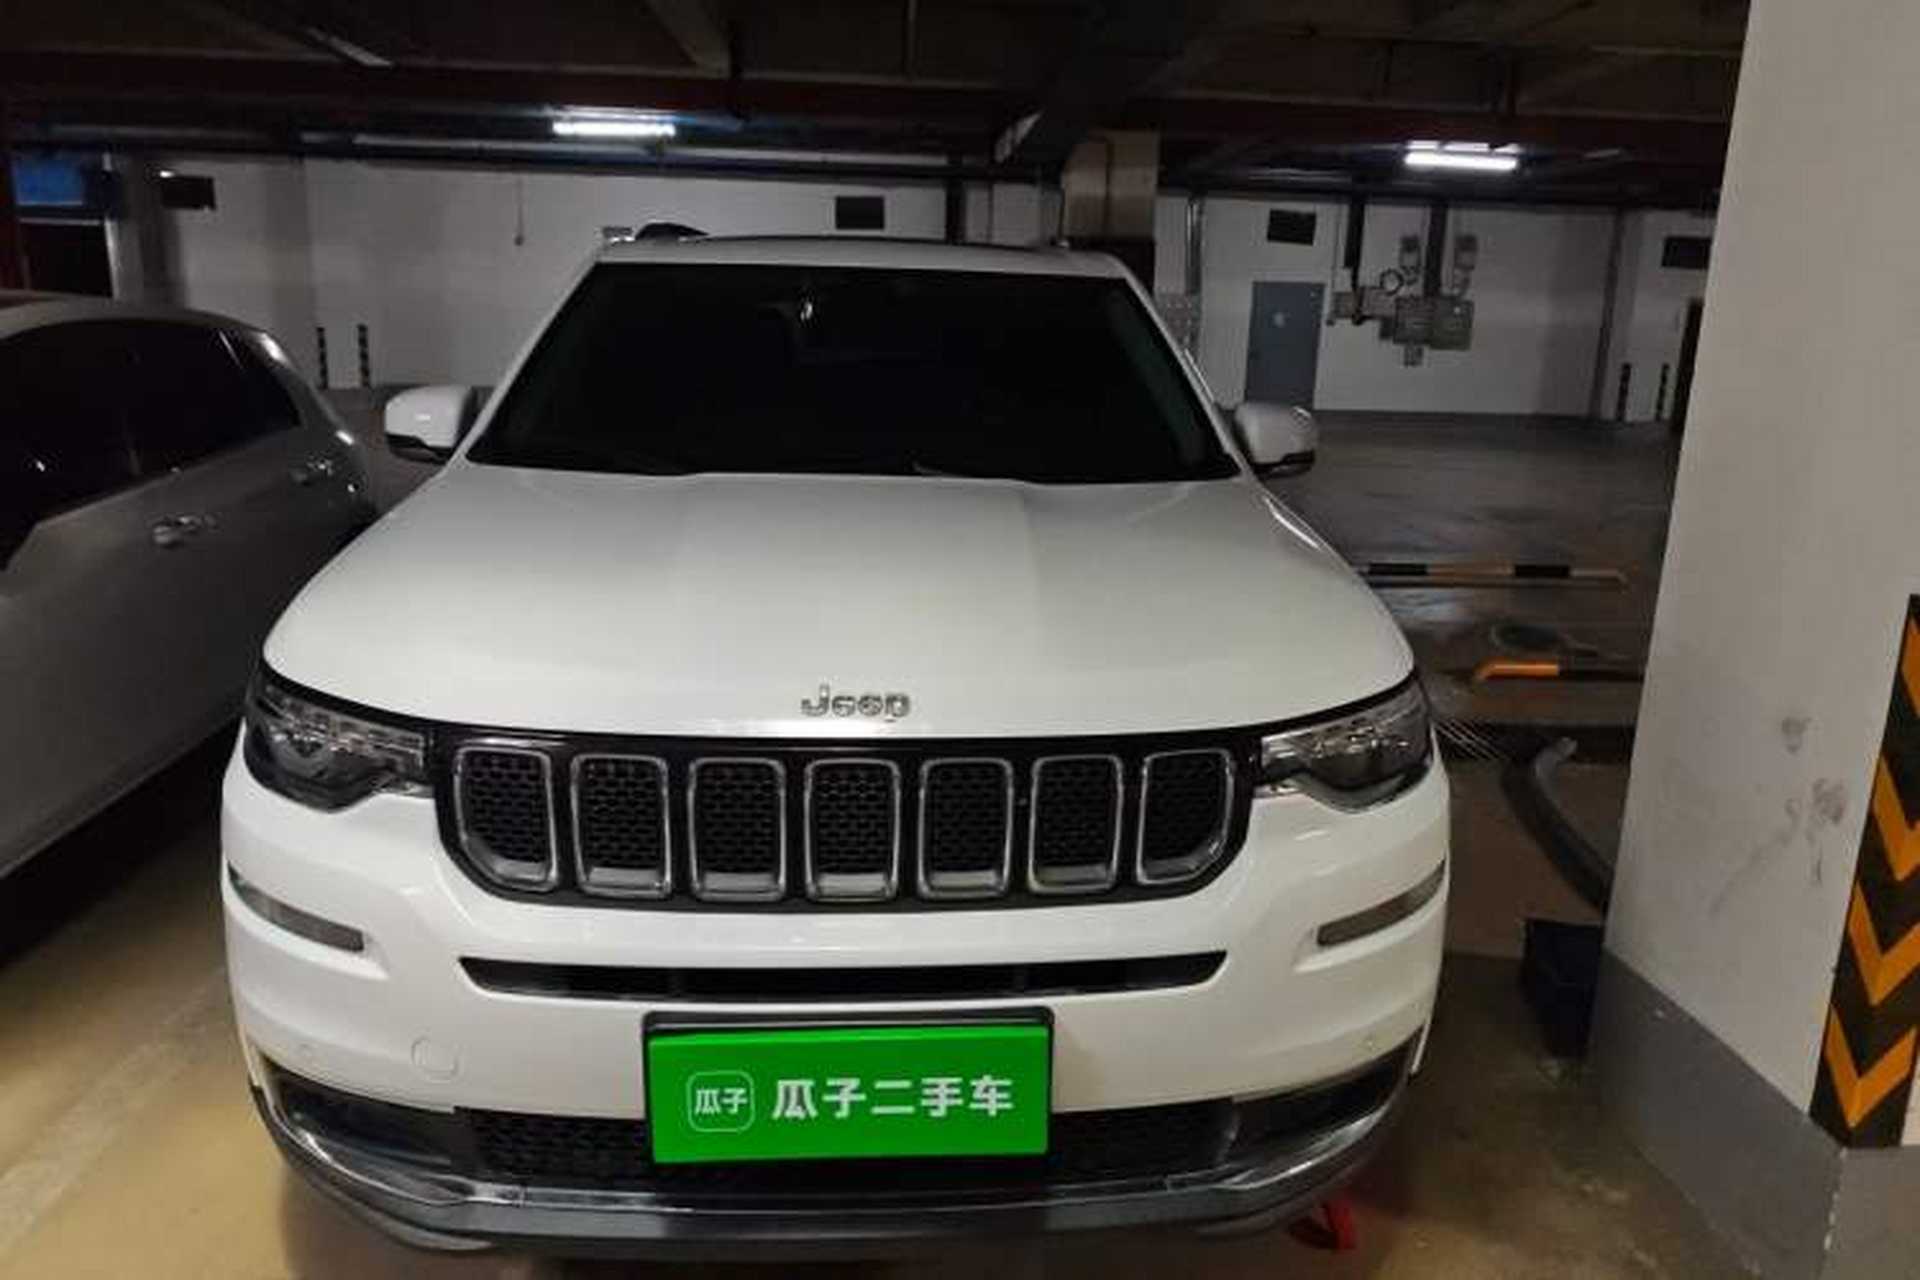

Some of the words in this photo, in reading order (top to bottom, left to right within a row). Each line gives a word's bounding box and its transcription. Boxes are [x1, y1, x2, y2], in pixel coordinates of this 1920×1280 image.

[800, 683, 911, 723] Jeep
[694, 1087, 748, 1116] 瓜子
[771, 1075, 1014, 1119] 瓜子二手车
